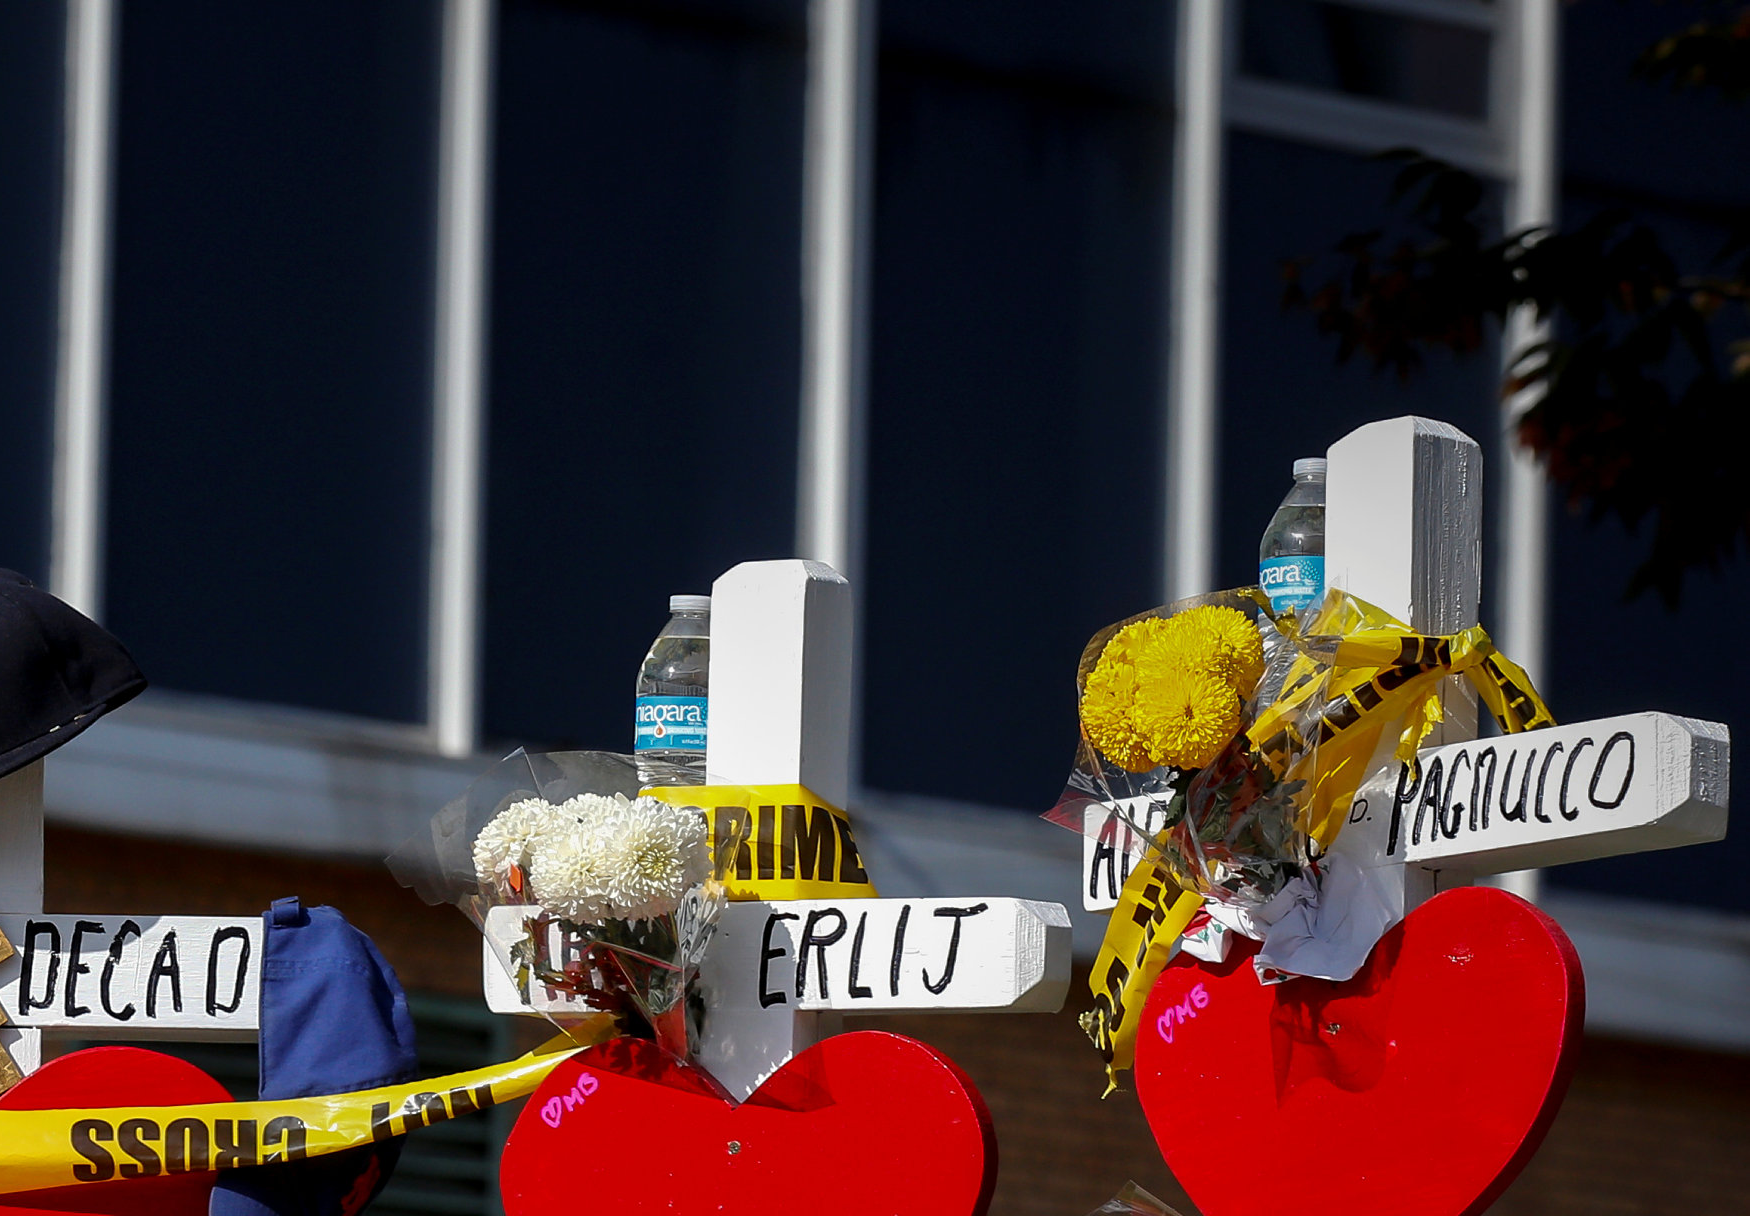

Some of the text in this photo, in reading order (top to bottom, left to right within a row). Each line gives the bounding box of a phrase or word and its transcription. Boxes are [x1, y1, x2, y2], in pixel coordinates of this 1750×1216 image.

[1348, 731, 1636, 858] D. PAGNUCCO
[758, 902, 988, 1009] ERLIJ
[1175, 981, 1211, 1024] MB
[561, 1071, 600, 1114] MB
[70, 1115, 307, 1183] CROSS
